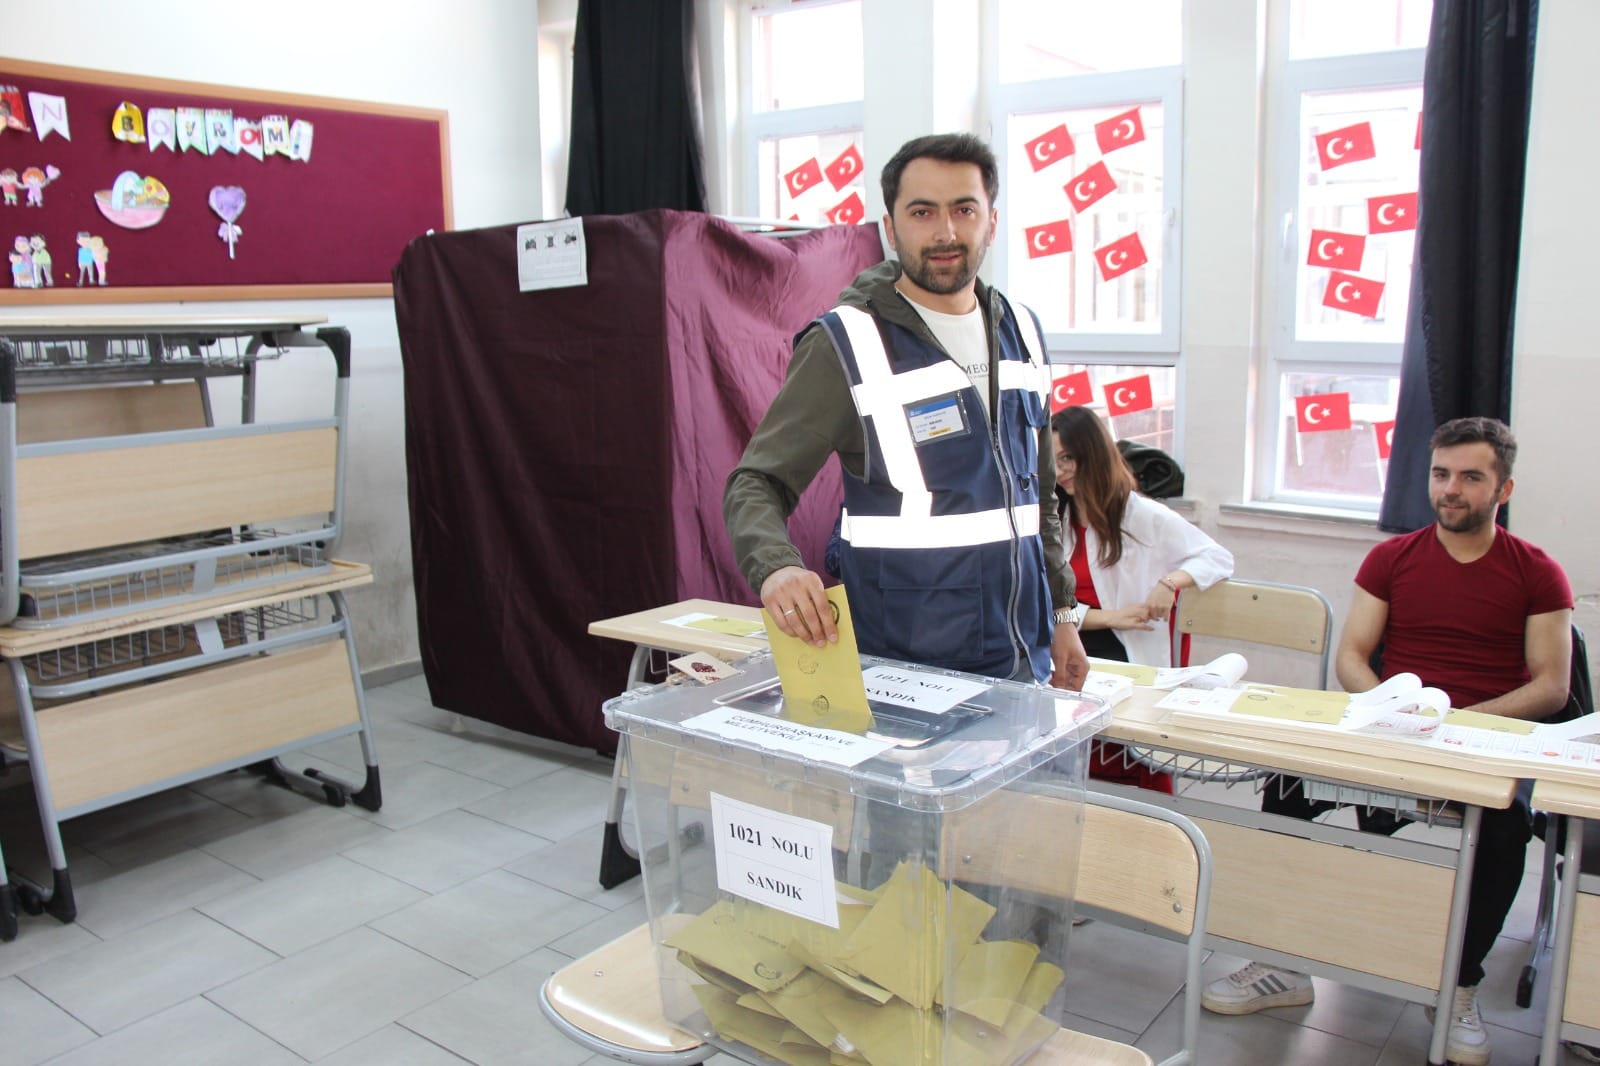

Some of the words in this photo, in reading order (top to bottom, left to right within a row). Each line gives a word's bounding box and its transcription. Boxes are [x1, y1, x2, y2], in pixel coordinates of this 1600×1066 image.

[729, 822, 762, 847] 1021
[771, 836, 814, 861] NOLU
[746, 871, 804, 901] SANDIK
